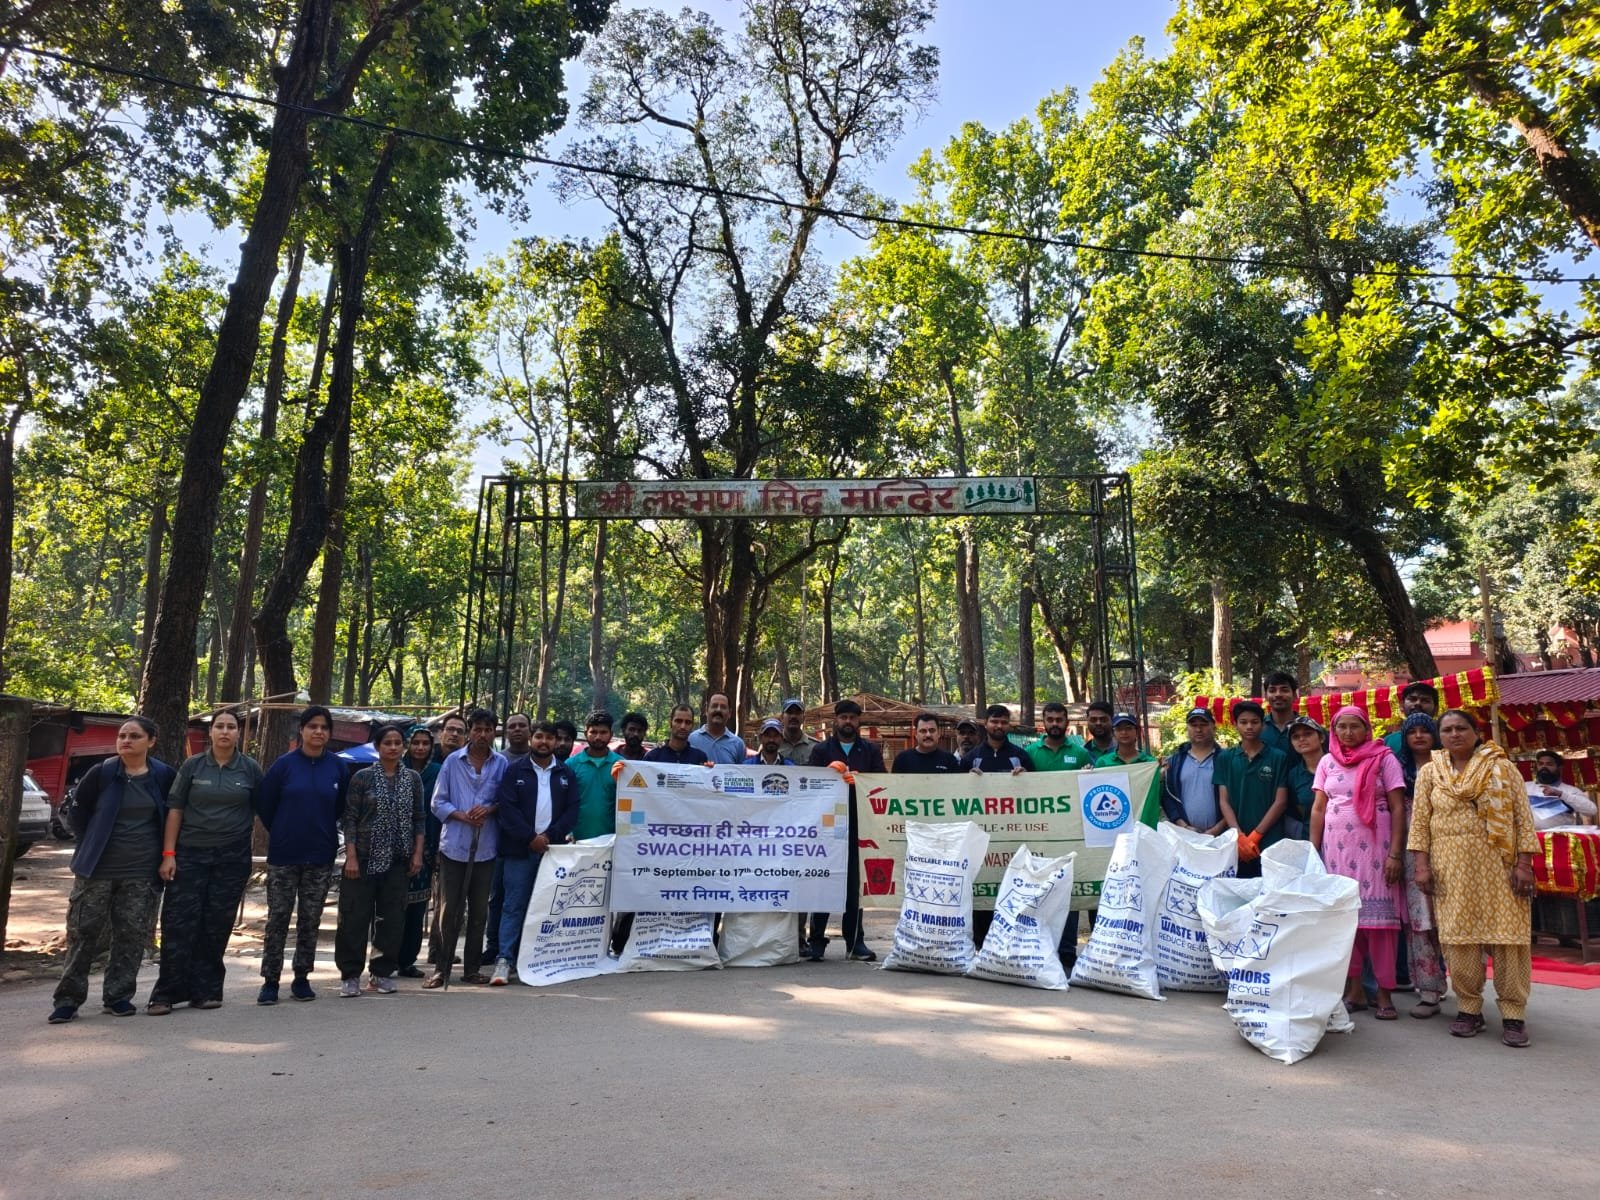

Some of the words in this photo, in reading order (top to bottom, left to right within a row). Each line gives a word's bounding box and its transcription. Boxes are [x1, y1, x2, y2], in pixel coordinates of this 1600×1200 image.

[596, 481, 635, 514] श्री
[642, 490, 745, 514] लक्ष्मण
[869, 797, 945, 816] WASTE
[952, 795, 1071, 816] WARRIORS
[647, 823, 712, 838] स्वच्छता
[716, 820, 733, 840] ही
[737, 820, 770, 838] सेवा
[774, 825, 818, 839] 2026
[637, 842, 752, 857] SWACHHATA
[758, 843, 776, 857] HI
[780, 843, 827, 858] SEVA
[632, 867, 650, 876] 17th
[653, 867, 717, 879] September
[719, 868, 731, 877] to
[734, 867, 751, 877] 17th
[754, 867, 802, 879] October,
[804, 869, 830, 878] 2026
[660, 888, 689, 901] नगर
[692, 886, 734, 903] निगम,
[738, 886, 790, 906] देहरादून
[562, 915, 605, 928] WARRIORS
[921, 913, 965, 928] WARRIORS
[993, 911, 1014, 933] ASTE
[1161, 919, 1191, 940] WASTE
[1158, 932, 1187, 948] REDUCE
[1244, 1000, 1271, 1009] DISPOSAL
